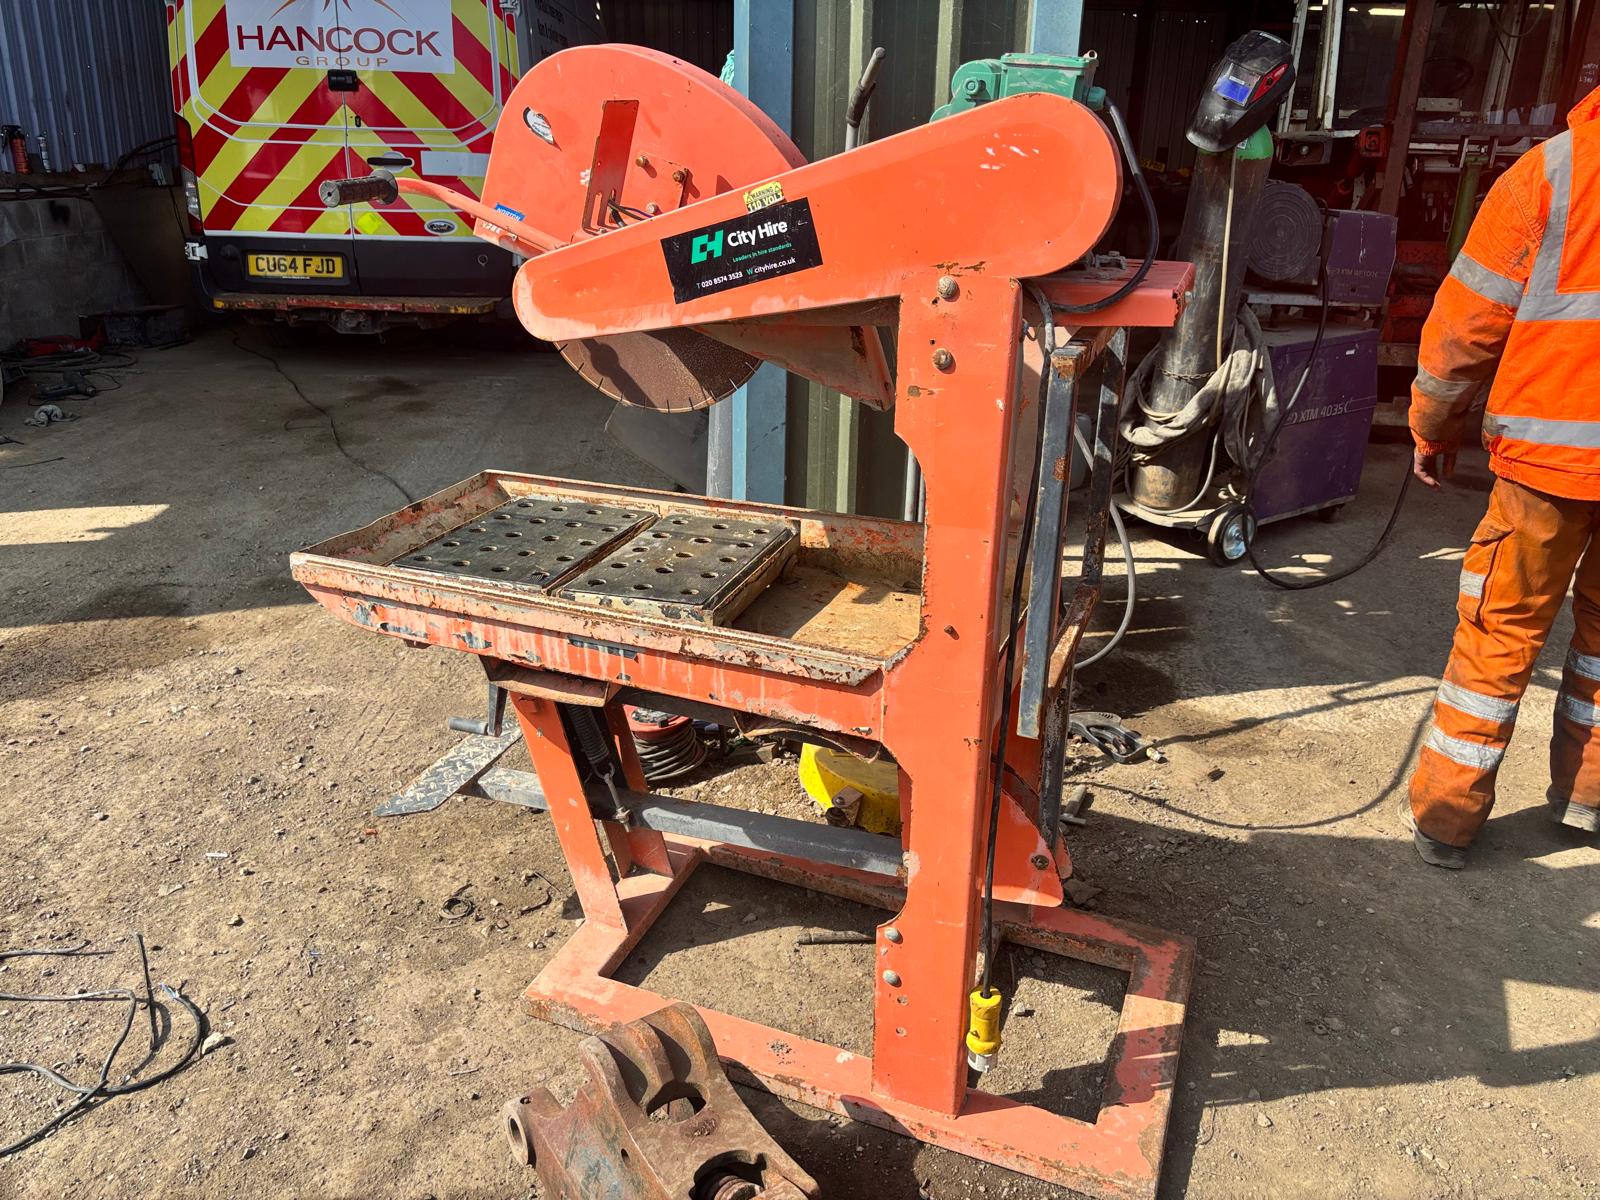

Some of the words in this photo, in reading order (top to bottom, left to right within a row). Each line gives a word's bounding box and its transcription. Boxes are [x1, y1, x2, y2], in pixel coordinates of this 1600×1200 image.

[236, 24, 442, 57] HANCOCK
[295, 55, 389, 67] GROUP
[747, 200, 762, 212] 110
[762, 191, 783, 208] VOLT
[727, 229, 757, 248] City
[757, 220, 788, 238] Hire
[757, 248, 768, 257] hire
[767, 242, 793, 255] standards
[255, 256, 298, 274] CU64
[303, 258, 336, 274] FJD
[701, 279, 713, 289] 020
[713, 275, 728, 286] 8574
[728, 271, 743, 281] 3523
[746, 267, 753, 276] W
[754, 256, 796, 274] cityhire.co.uk
